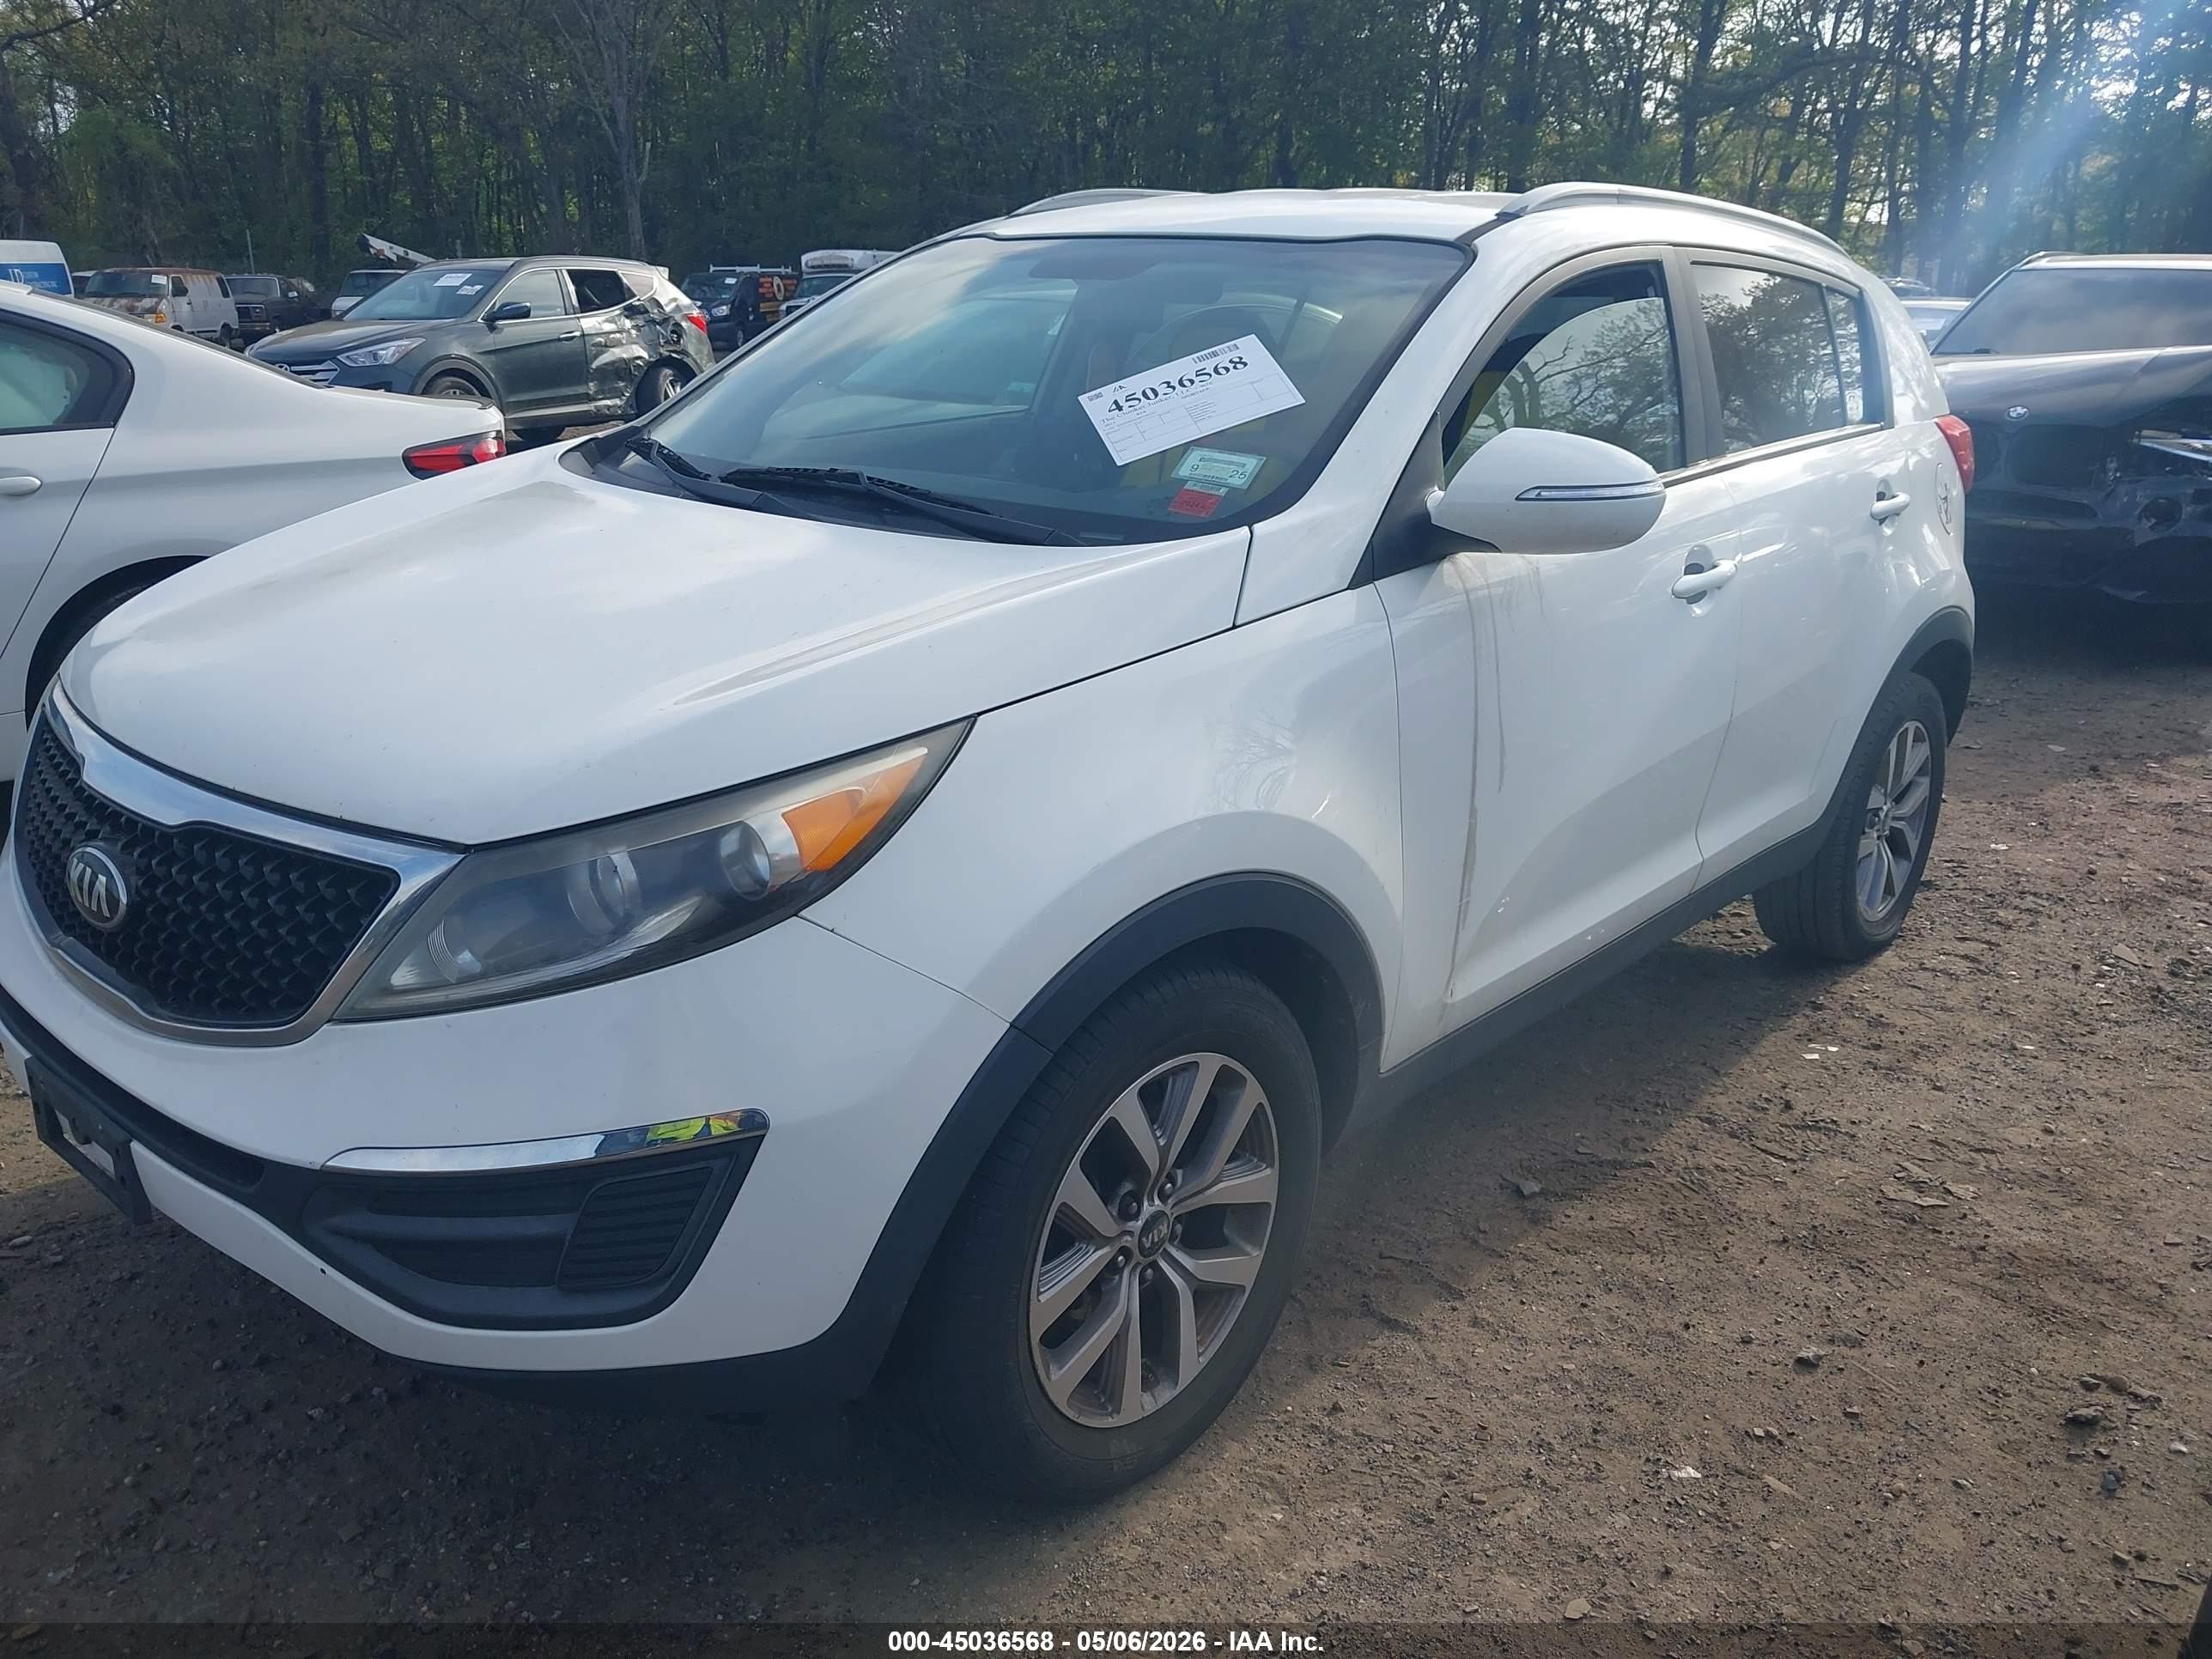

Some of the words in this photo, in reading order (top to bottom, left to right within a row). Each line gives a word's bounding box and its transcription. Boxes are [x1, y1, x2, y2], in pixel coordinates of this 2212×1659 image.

[1108, 356, 1249, 413] 45036568
[1189, 464, 1200, 472] 9
[1229, 470, 1248, 480] 25
[70, 857, 111, 918] KIA
